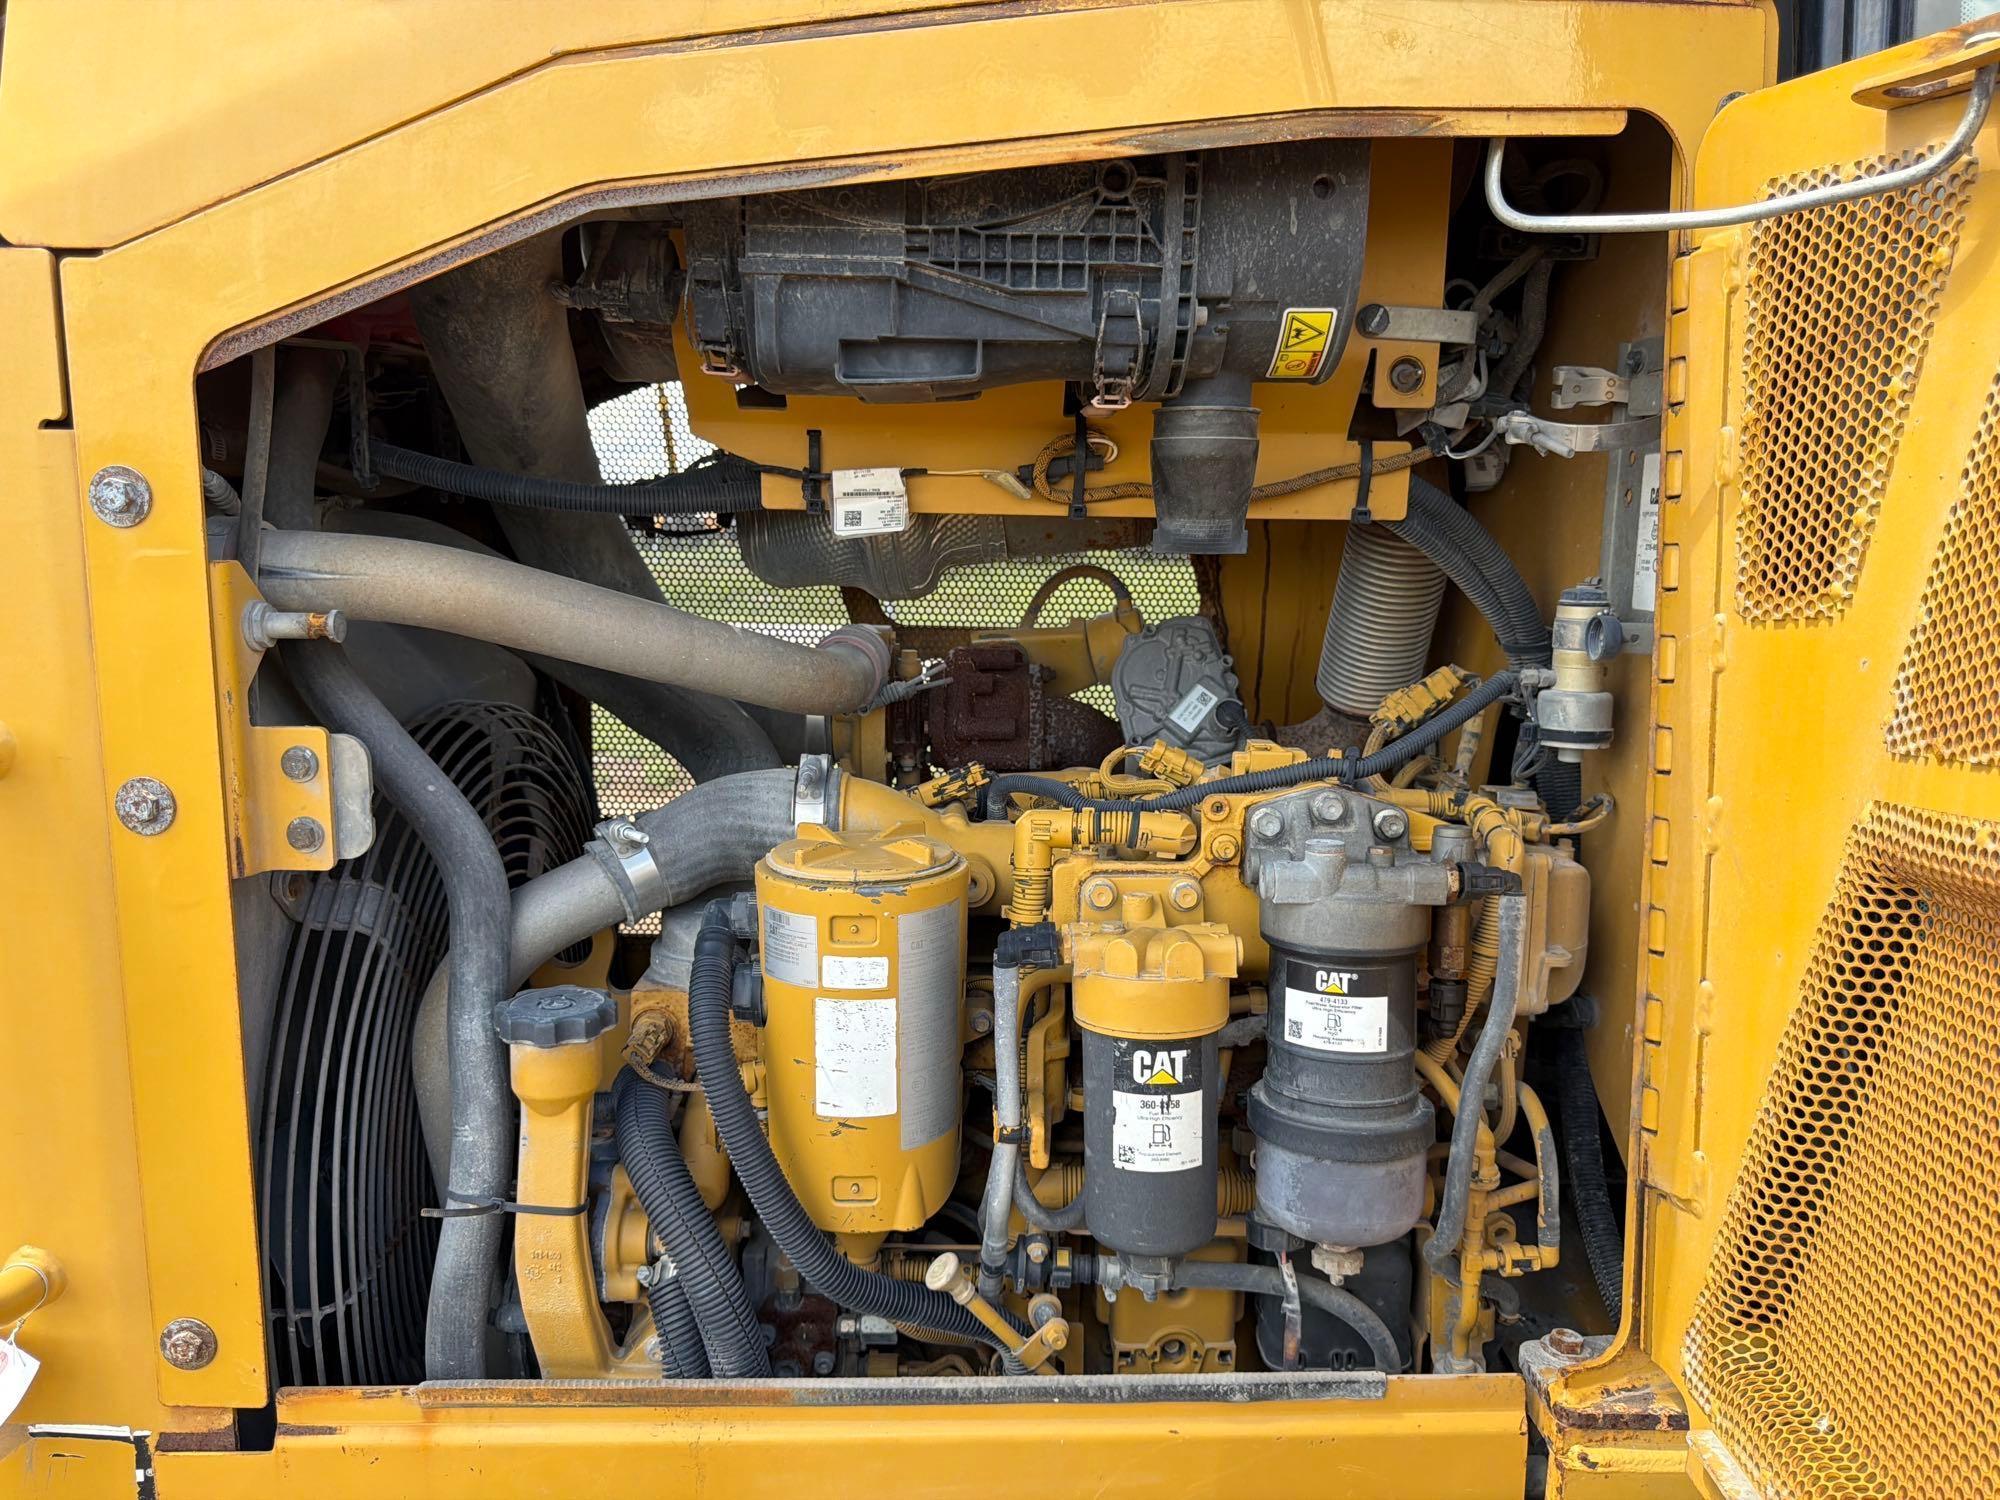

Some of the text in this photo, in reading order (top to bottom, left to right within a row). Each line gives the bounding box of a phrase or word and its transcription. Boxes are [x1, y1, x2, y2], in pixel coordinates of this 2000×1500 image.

[1650, 487, 1660, 505] CA
[1315, 970, 1351, 994] CAT
[1133, 1050, 1187, 1085] CAT
[1140, 1099, 1181, 1110] 360-58
